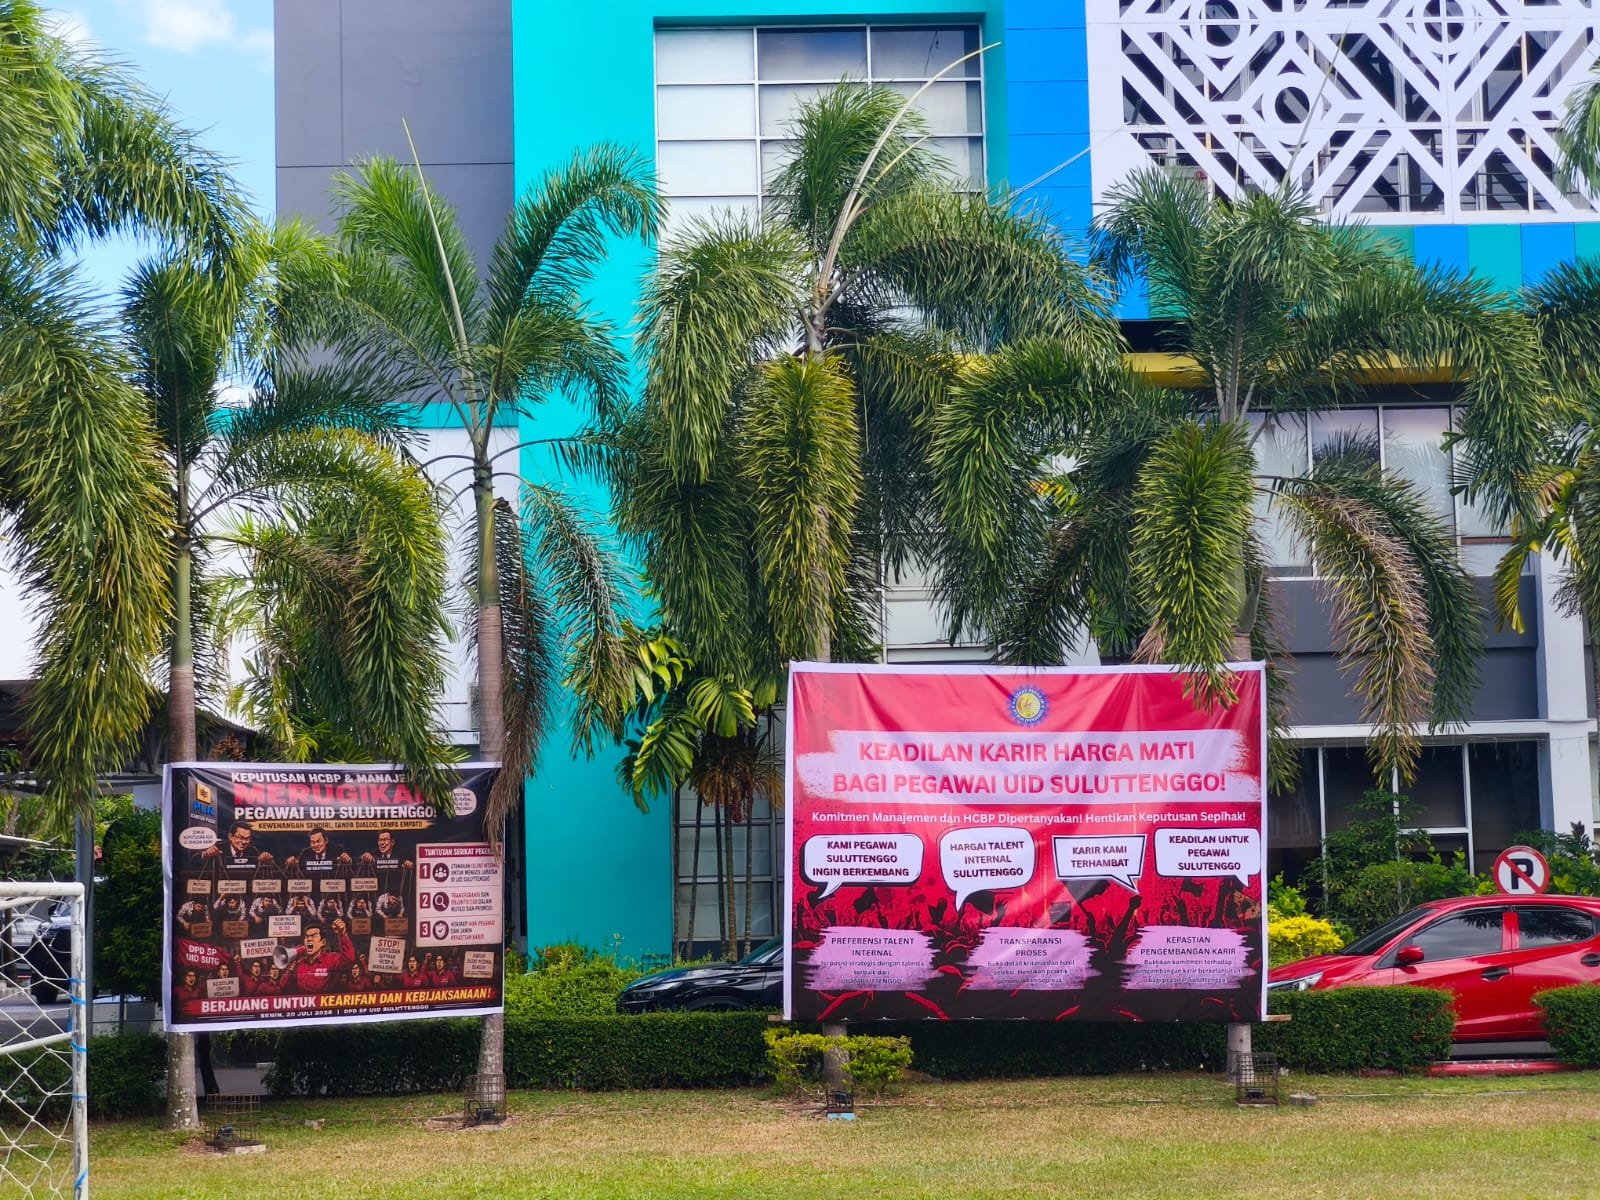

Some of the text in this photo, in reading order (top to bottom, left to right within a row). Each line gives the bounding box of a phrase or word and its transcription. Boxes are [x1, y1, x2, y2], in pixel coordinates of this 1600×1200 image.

[859, 741, 1195, 762] KEADILAN KARIR HARGA MATI
[232, 772, 306, 784] KEPUTUSAN
[309, 773, 341, 784] HCBP
[356, 773, 428, 784] MANAJE
[833, 772, 1226, 794] BAGI PEGAWAI UID SULUTTENGGO!
[192, 801, 215, 817] PLN
[234, 805, 437, 820] PEGAWAI UID SULUTTENGGO!
[811, 811, 1246, 826] Komitmen Manajemen dan HCBP Dipertanyakan! Hentikan Keputusan Sepihak!
[258, 822, 305, 830] KEWENANGAN
[334, 821, 354, 829] TANPA
[380, 820, 399, 829] TANPA
[827, 840, 897, 850] KAMI PEGAWAI
[1169, 835, 1249, 844] KEADILAN UNTUK
[950, 840, 1025, 852] HARGAI TALENT
[1072, 845, 1127, 856] KARIR KAMI
[1188, 848, 1230, 857] PEGAWAI
[826, 854, 898, 864] SULUTTENGGO
[964, 854, 1012, 865] INTERNAL
[1071, 858, 1129, 868] TERHAMBAT
[422, 864, 428, 878] 1
[1178, 861, 1241, 871] SULUTENGGO
[812, 867, 910, 877] INGIN BERKEMBANG
[953, 867, 1024, 878] SULUTTENGGO
[422, 894, 428, 907] 2
[422, 923, 428, 936] 3
[378, 939, 400, 948] STOP!
[831, 937, 915, 945] PREFERENSI TALENT
[999, 937, 1062, 945] TRANSPARANSI
[1166, 936, 1211, 944] KEPASTIAN
[188, 944, 217, 956] DPD SP
[852, 949, 893, 957] INTERNAL
[1015, 949, 1048, 957] PROSES
[1140, 947, 1236, 956] PENGEMBANGAN KARIR
[186, 953, 220, 965] UID SUTG
[201, 987, 492, 1013] BERJUANG UNTUK KEARIFAN DAN KEBIJAKSANAAN!
